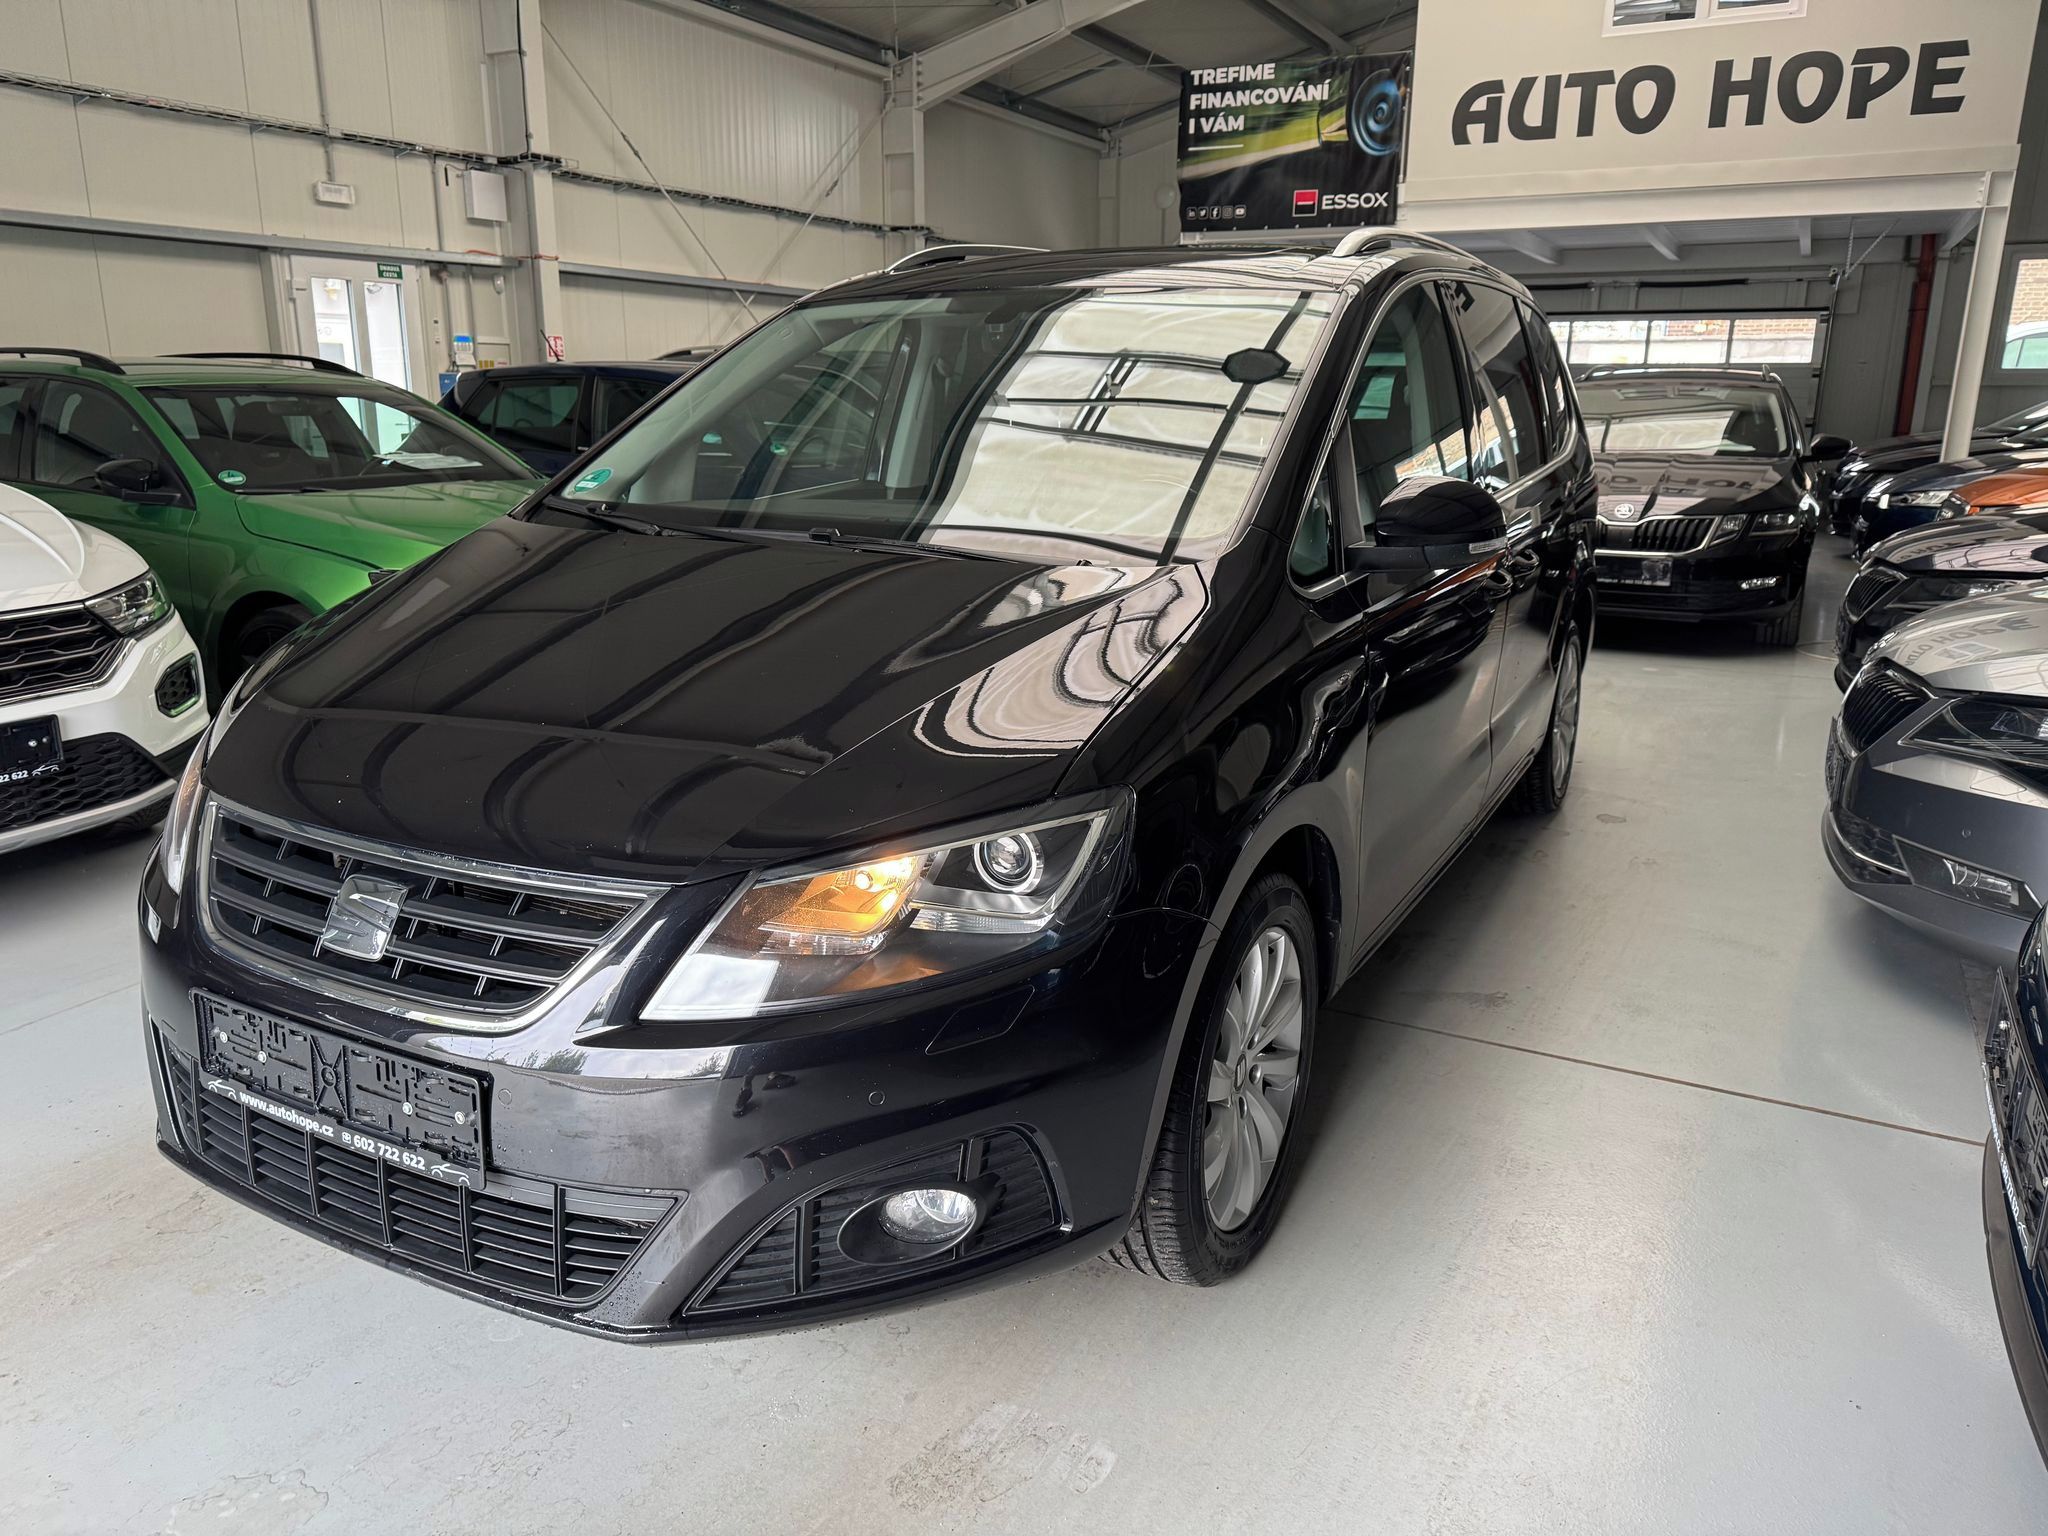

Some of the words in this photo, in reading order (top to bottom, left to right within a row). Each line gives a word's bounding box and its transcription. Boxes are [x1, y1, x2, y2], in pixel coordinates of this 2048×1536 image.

[1190, 63, 1276, 86] TREFIME
[1189, 79, 1332, 110] FINANCOVÁNÍ
[1451, 64, 1676, 146] AUTO
[1708, 39, 1971, 129] HOPE
[1188, 117, 1195, 134] I
[1200, 112, 1245, 133] VÁM
[1321, 191, 1389, 211] ESSOX
[11, 770, 29, 780] 622
[240, 1092, 334, 1138] www.autohope.cz
[353, 1135, 376, 1153] 602
[377, 1143, 400, 1162] 722
[402, 1152, 426, 1171] 622
